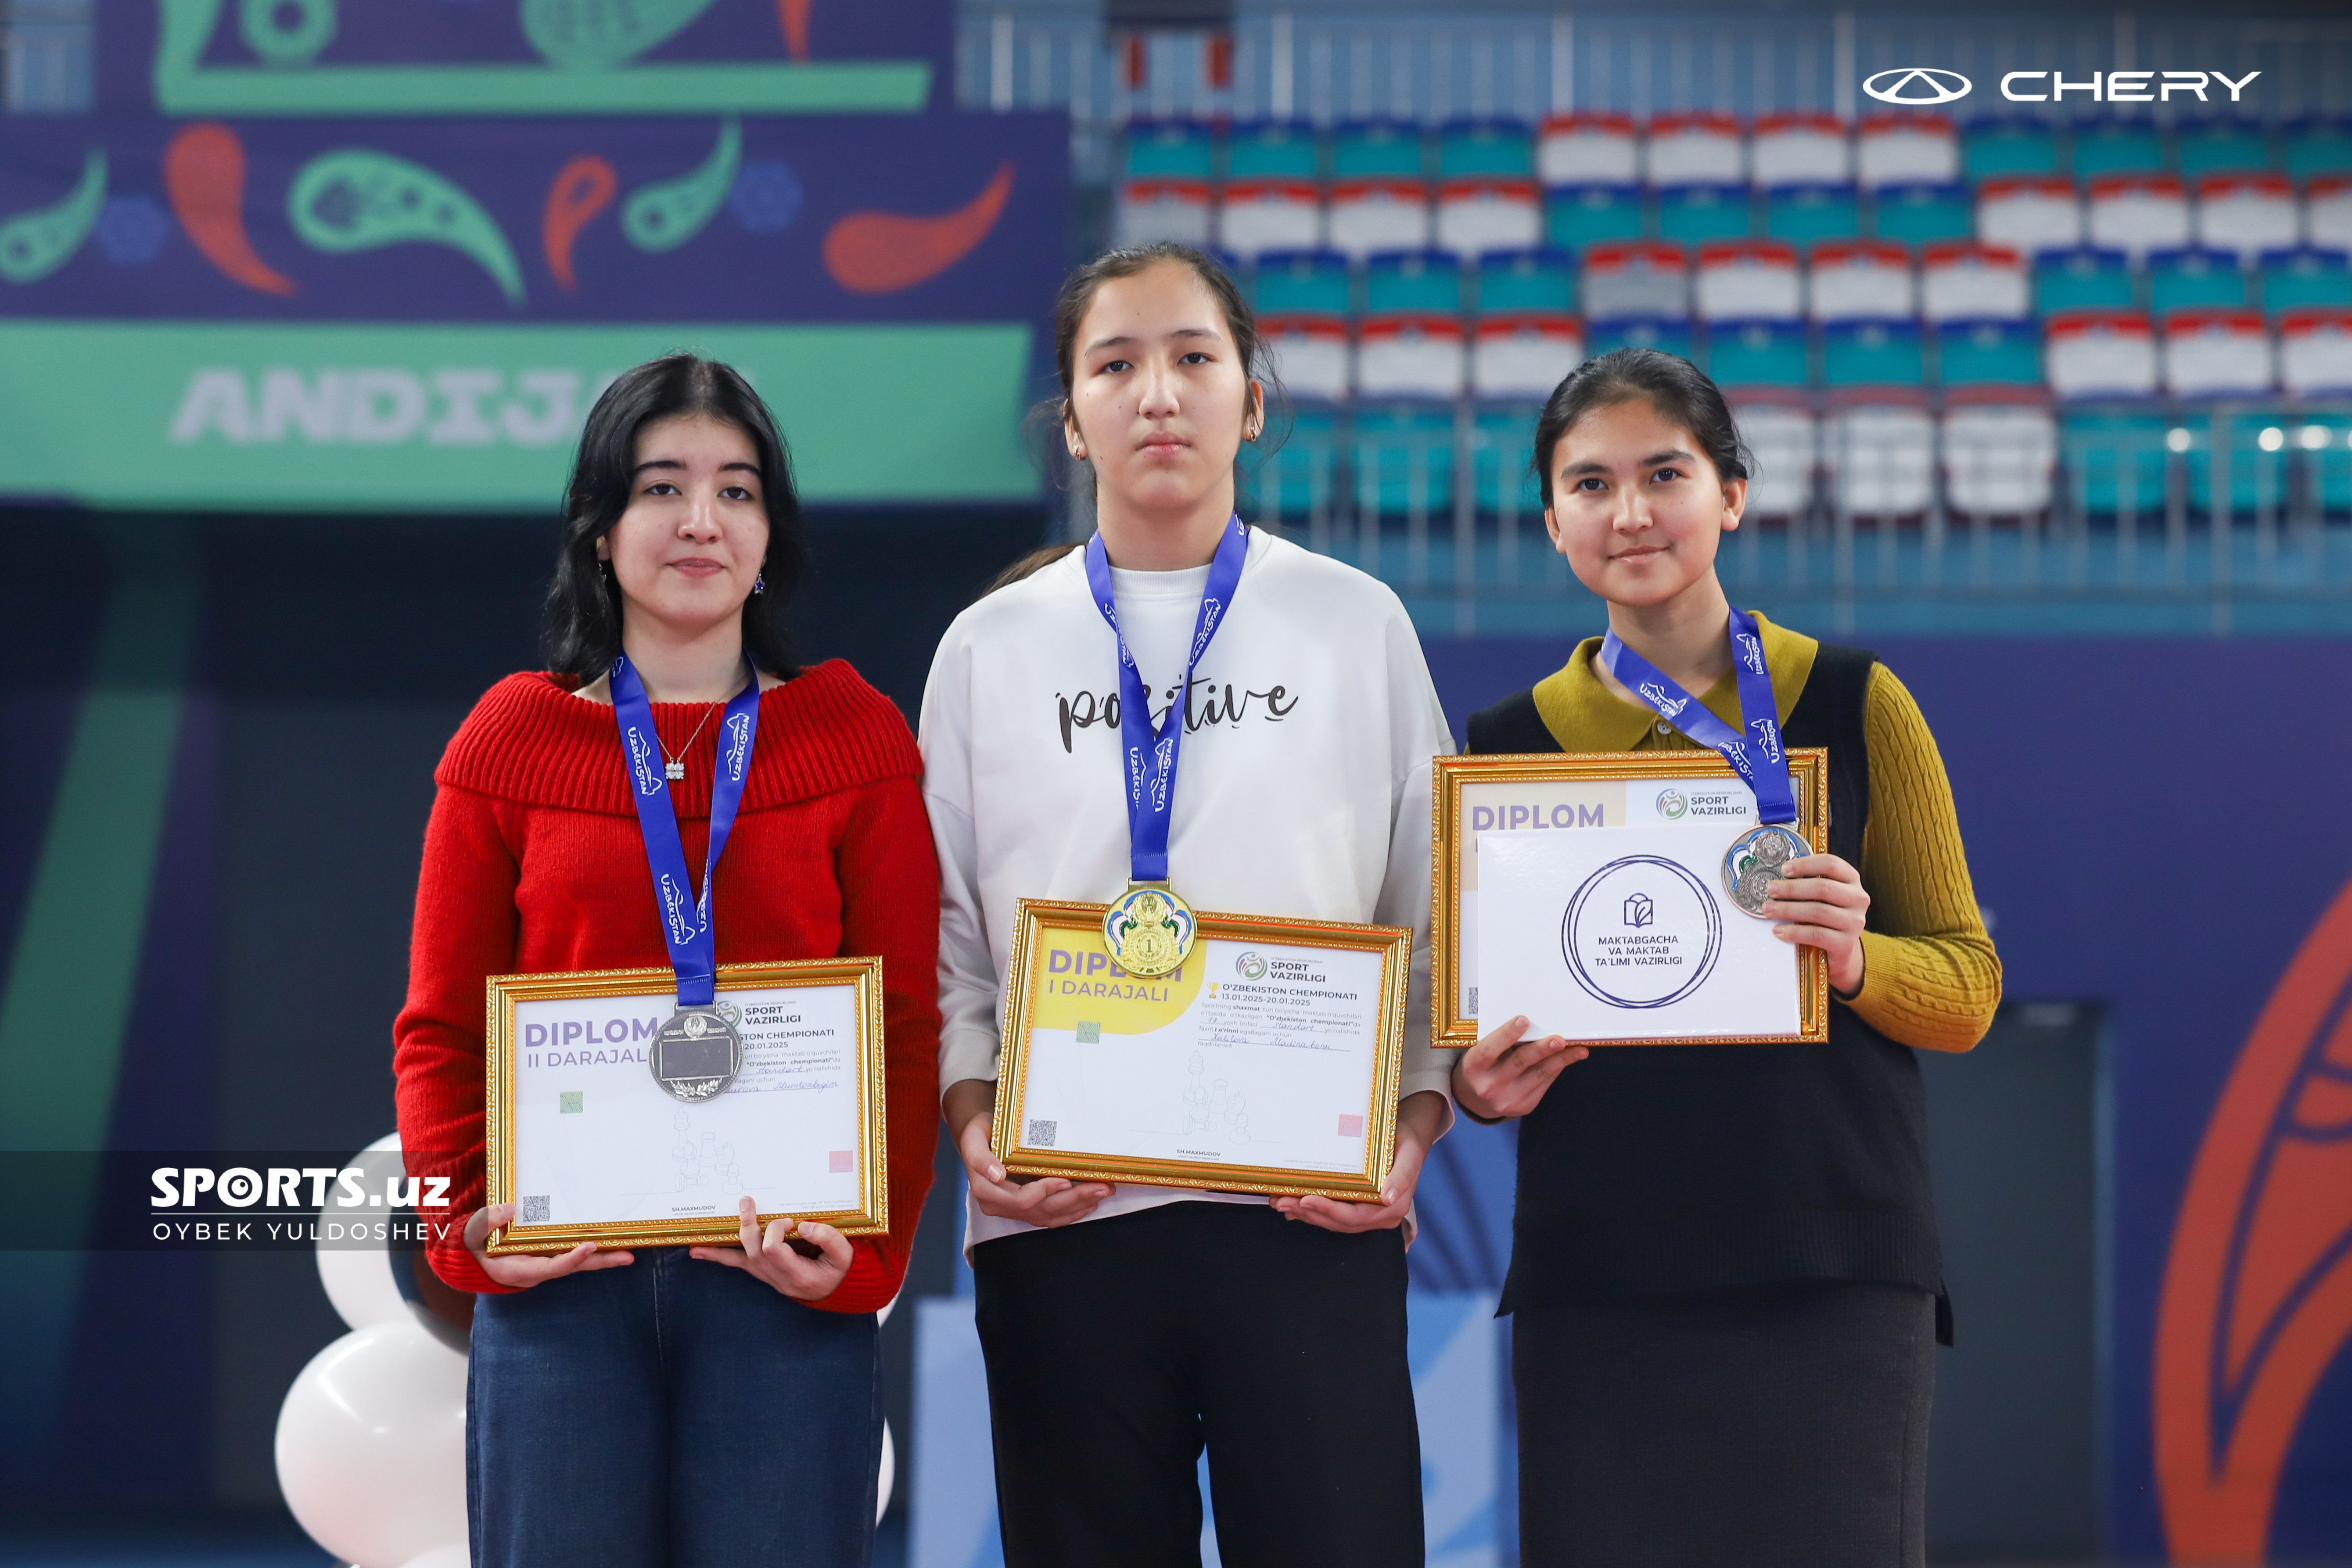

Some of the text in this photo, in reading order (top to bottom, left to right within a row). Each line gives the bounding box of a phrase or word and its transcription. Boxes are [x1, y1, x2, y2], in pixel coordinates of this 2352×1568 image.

[172, 368, 614, 445] ANDIJ
[1189, 602, 1221, 666] UZBEKISTAN
[1640, 683, 1678, 717] UZBEKISTAN
[1057, 672, 1298, 753] poitive
[732, 715, 750, 781] UZBEKISTAN
[628, 726, 649, 795] UZBEKISTAN
[1155, 739, 1174, 812] UZBEKISTAN
[1691, 796, 1729, 805] SPORT
[1472, 804, 1604, 830] DIPLOM
[1691, 806, 1746, 815] VAZIRLIGI
[661, 873, 682, 944] UZBEKISTAN
[1598, 935, 1678, 945] MAKTABGACHA
[1608, 946, 1669, 955] VA MAKTAB
[1271, 962, 1309, 971] SPORT
[1595, 956, 1682, 966] TA'LIMI VAZIRLIGI
[1270, 971, 1325, 983] VAZIRLIGI
[1049, 980, 1168, 1001] I DARAJALI
[1221, 993, 1311, 1006] 13.01.2025-20.01.2025
[1222, 983, 1357, 1000] O'ZBEKISTON CHEMPIONATI
[745, 1006, 783, 1015] SPORT
[745, 1015, 801, 1025] VAZIRLIGI
[525, 1017, 657, 1047] DIPLOM
[767, 1029, 834, 1039] CHEMPIONATI
[528, 1048, 647, 1068] II DARAJAL
